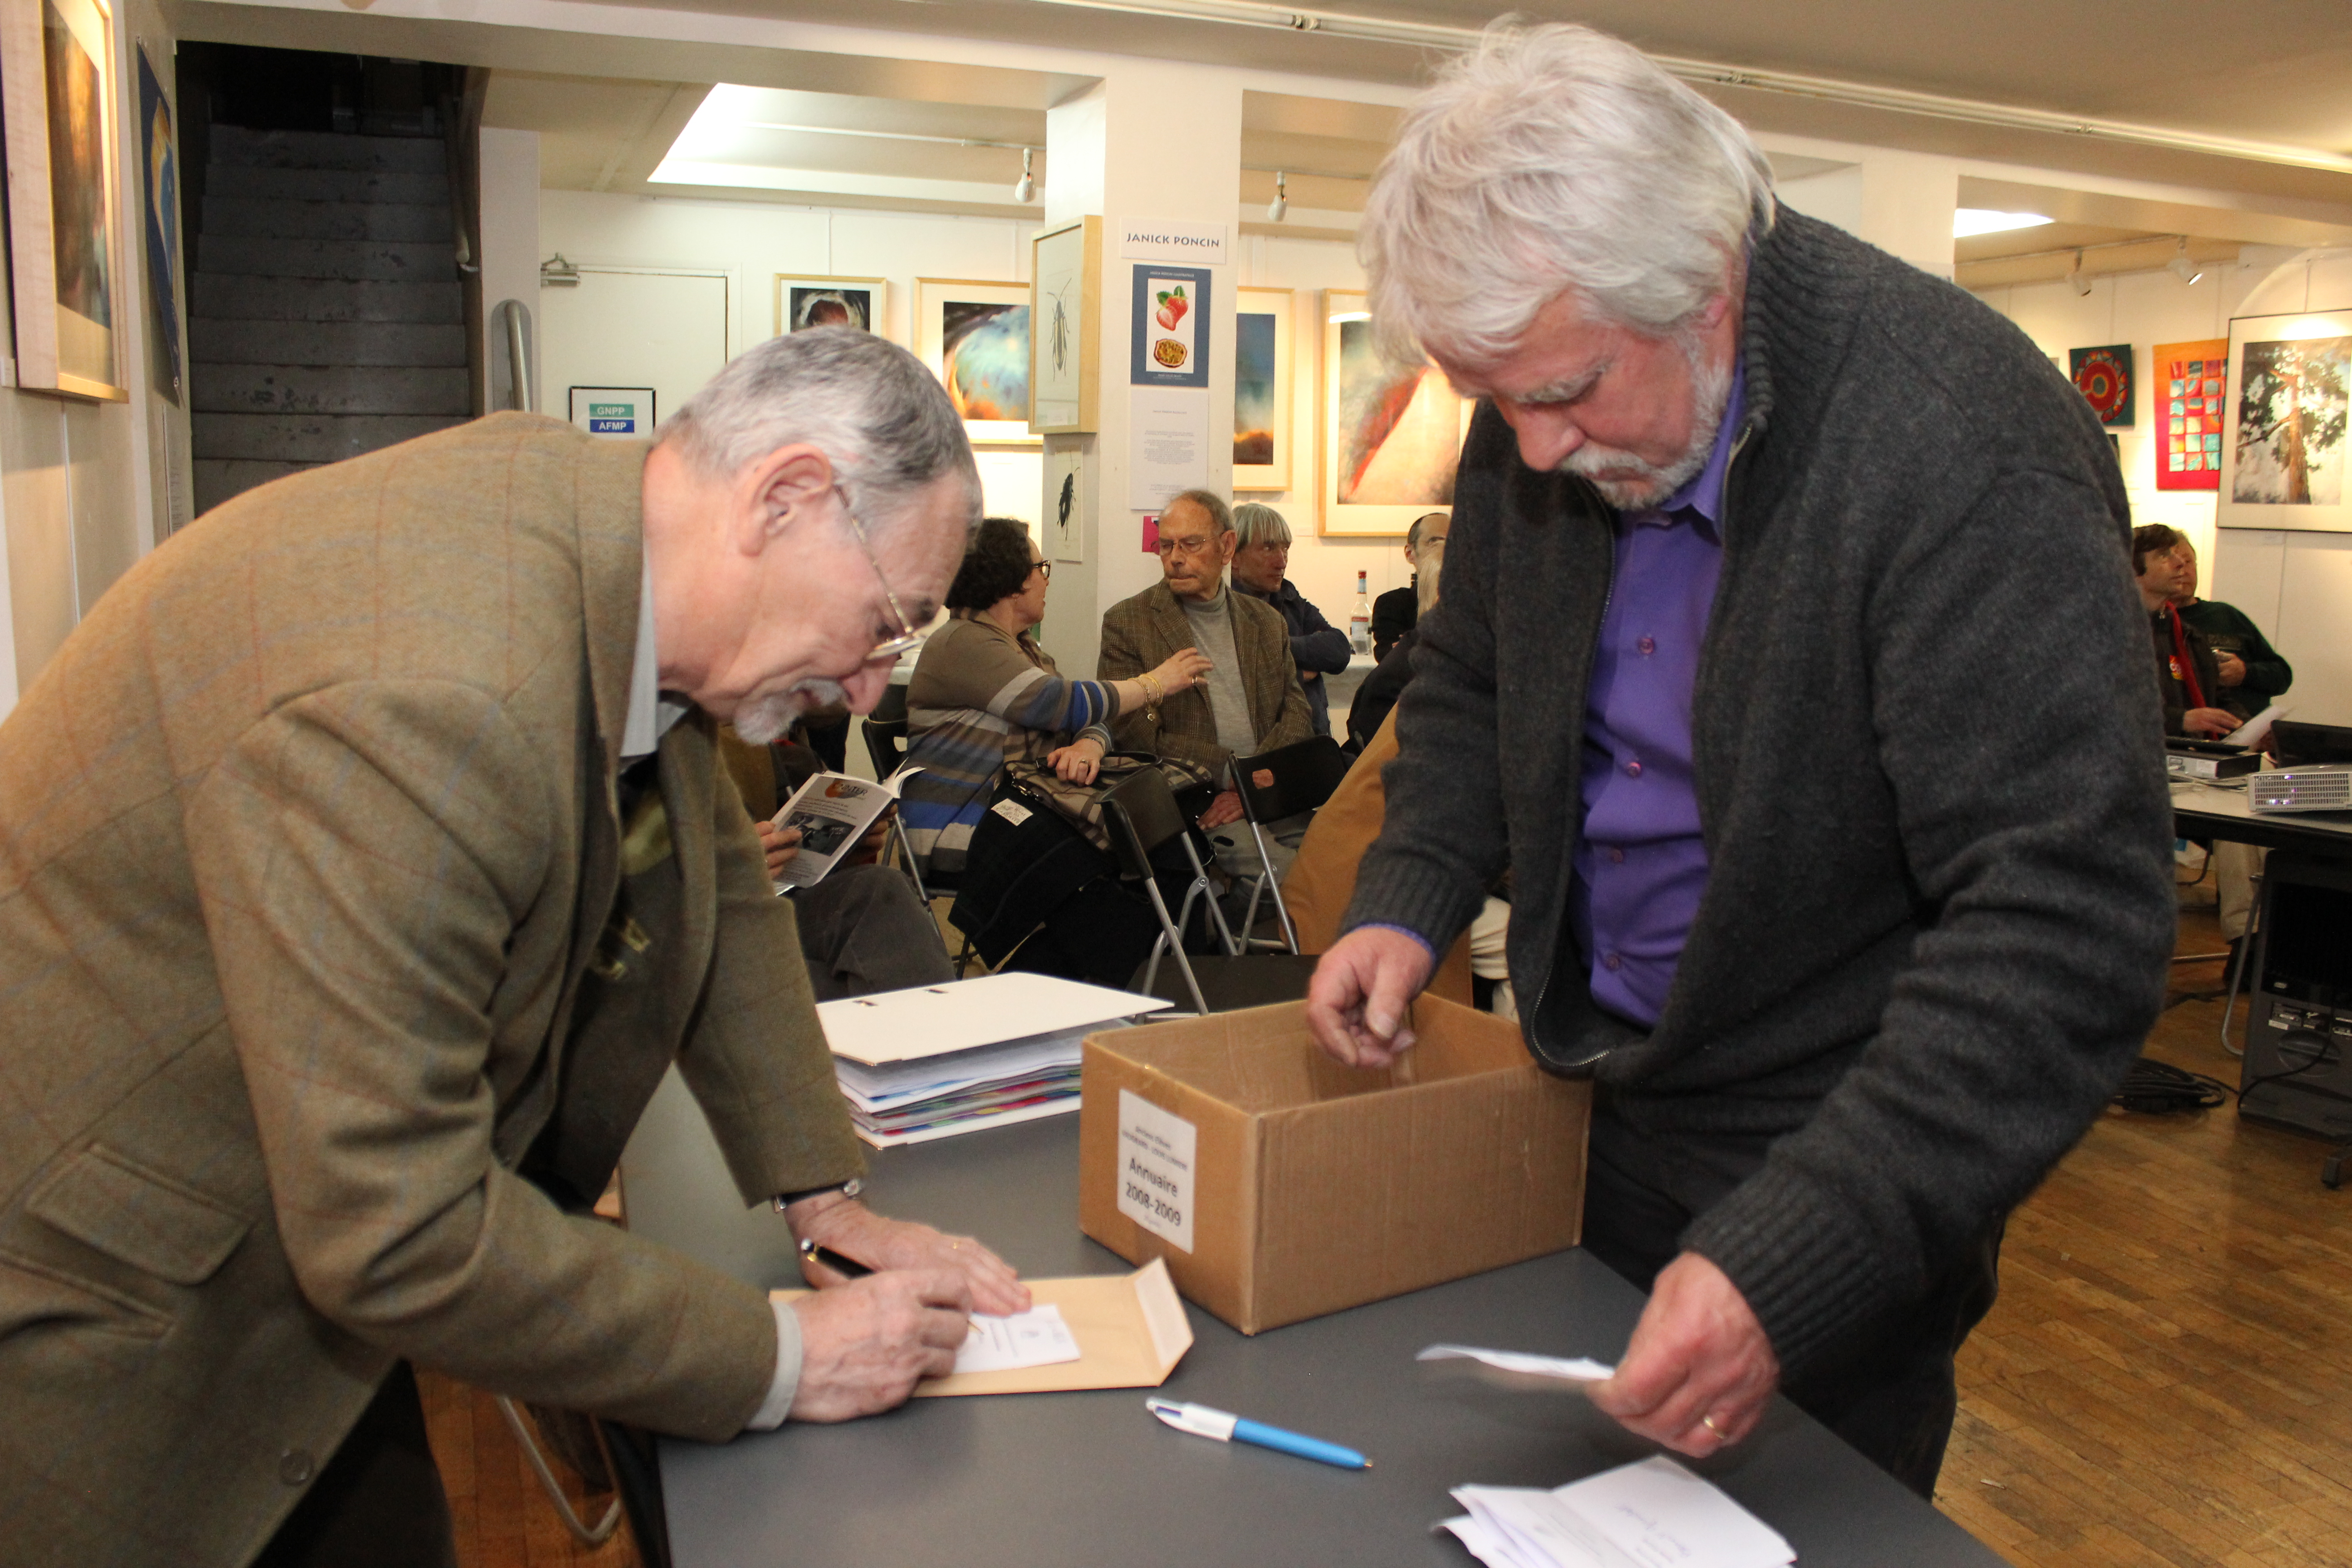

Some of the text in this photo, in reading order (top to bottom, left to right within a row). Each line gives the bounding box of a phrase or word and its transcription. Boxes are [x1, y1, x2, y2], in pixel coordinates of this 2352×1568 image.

[1127, 233, 1220, 247] JANICK PONCIN
[599, 422, 627, 431] AFMP
[1130, 1158, 1177, 1196] Annuaire
[1127, 1183, 1181, 1226] 2008-2009
